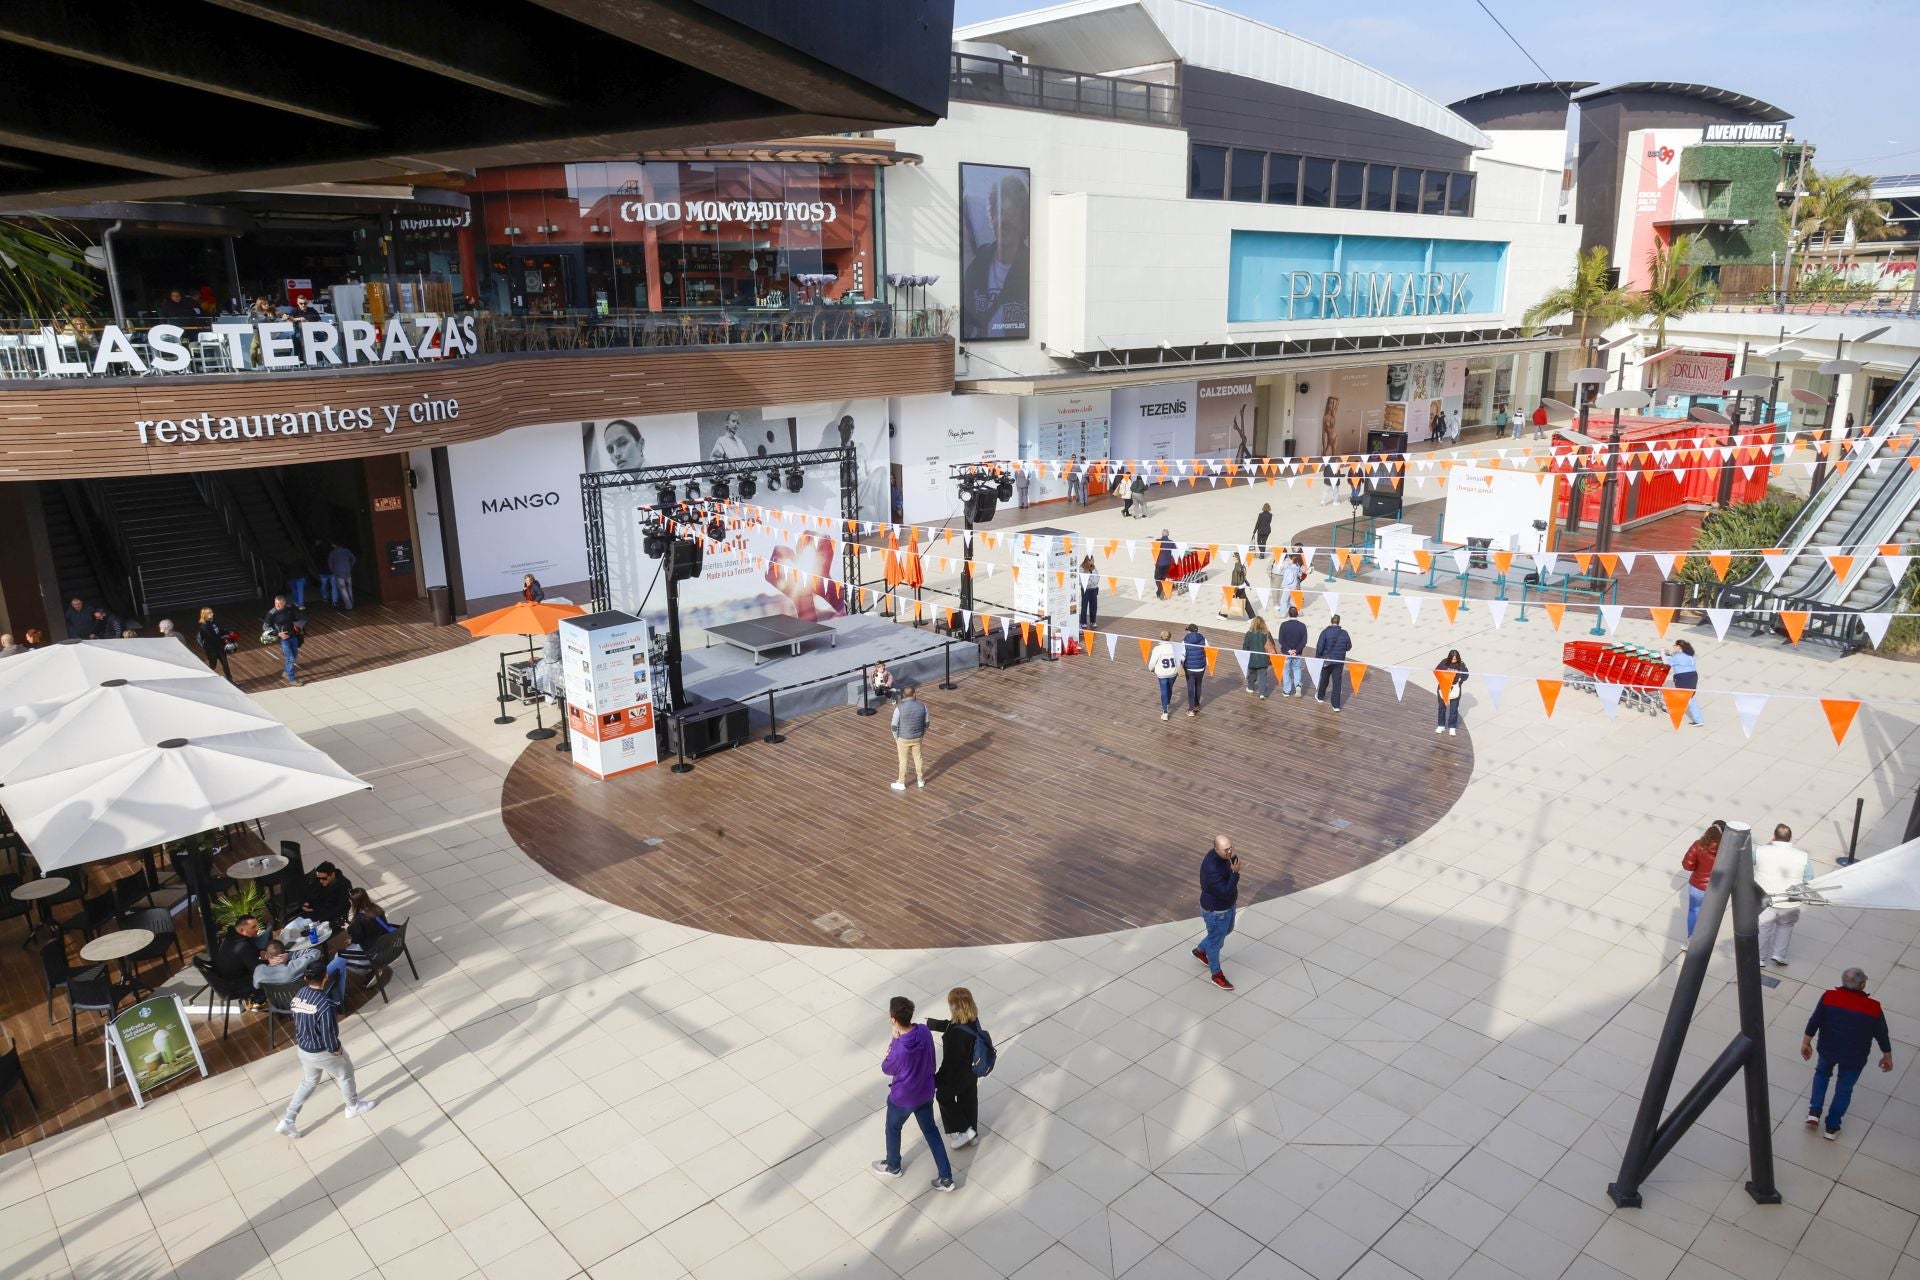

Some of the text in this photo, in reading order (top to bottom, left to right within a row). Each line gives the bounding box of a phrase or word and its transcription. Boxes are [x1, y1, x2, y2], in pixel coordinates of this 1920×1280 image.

[1705, 122, 1784, 140] AVENTÚRATE
[620, 200, 837, 223] (100 MONTADITOS)
[1287, 271, 1471, 321] PRIMARK
[991, 322, 1026, 330] JDSPORTS.ES
[40, 315, 478, 374] LAS TERRAZAS
[1673, 362, 1709, 380] DRUNI
[1199, 383, 1253, 398] CALZEDONIA
[135, 393, 459, 445] restaurantes y cine
[482, 492, 560, 514] MANGO
[1161, 657, 1176, 669] 91
